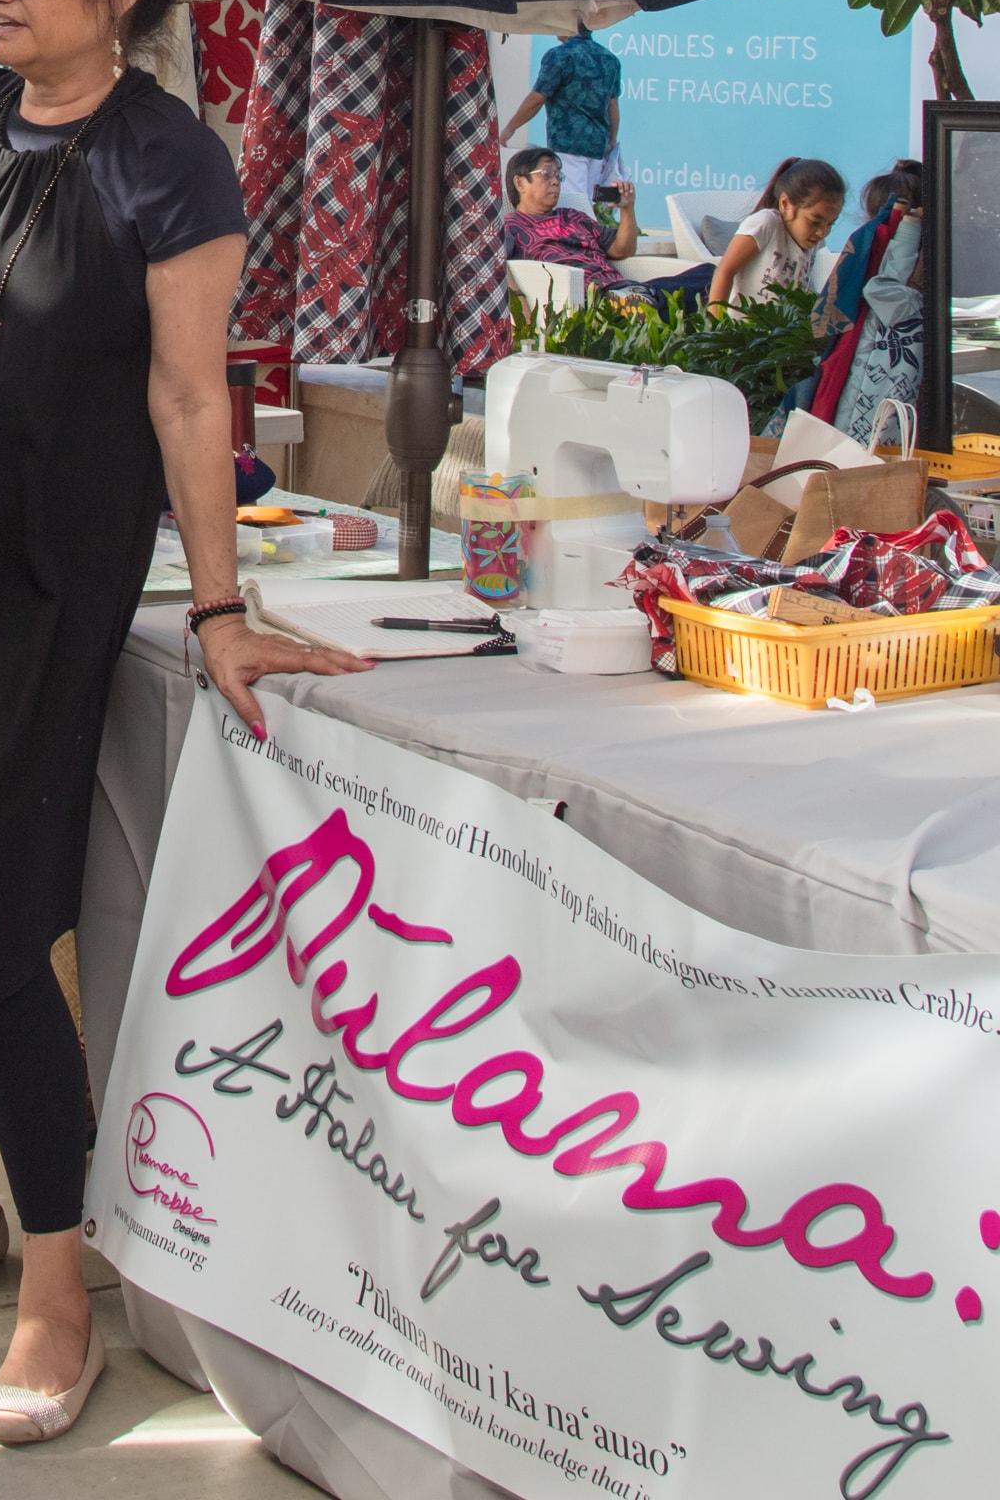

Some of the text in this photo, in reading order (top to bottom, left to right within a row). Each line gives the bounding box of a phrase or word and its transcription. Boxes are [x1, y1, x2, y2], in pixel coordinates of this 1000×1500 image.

[608, 33, 818, 60] CANDLES GIFTS
[667, 78, 834, 109] FRAGRANCES
[220, 713, 265, 755] Learn
[266, 736, 286, 767] the
[288, 753, 304, 778] art
[306, 759, 324, 785] of
[324, 774, 379, 816] sewing
[379, 786, 416, 827] from
[418, 812, 444, 840] one
[445, 822, 469, 850] of
[467, 825, 558, 899] Honolulu’s
[561, 883, 582, 924] top
[585, 894, 638, 956] fashion
[641, 933, 760, 999] designers,
[754, 975, 898, 1005] Puamana
[113, 1203, 208, 1273] www.puamana.org
[172, 1218, 211, 1245] Designs
[174, 1017, 292, 1096] A
[420, 1196, 552, 1301] for
[576, 1249, 952, 1500] Sewing
[269, 1285, 339, 1333] Always
[338, 1329, 406, 1372] embrace
[406, 1364, 433, 1394] and
[434, 1383, 484, 1430] cherish
[486, 1413, 588, 1482] knowledge
[591, 1464, 631, 1500] that
[432, 1340, 482, 1392] mau
[487, 1363, 497, 1401] i
[502, 1370, 540, 1422] ka
